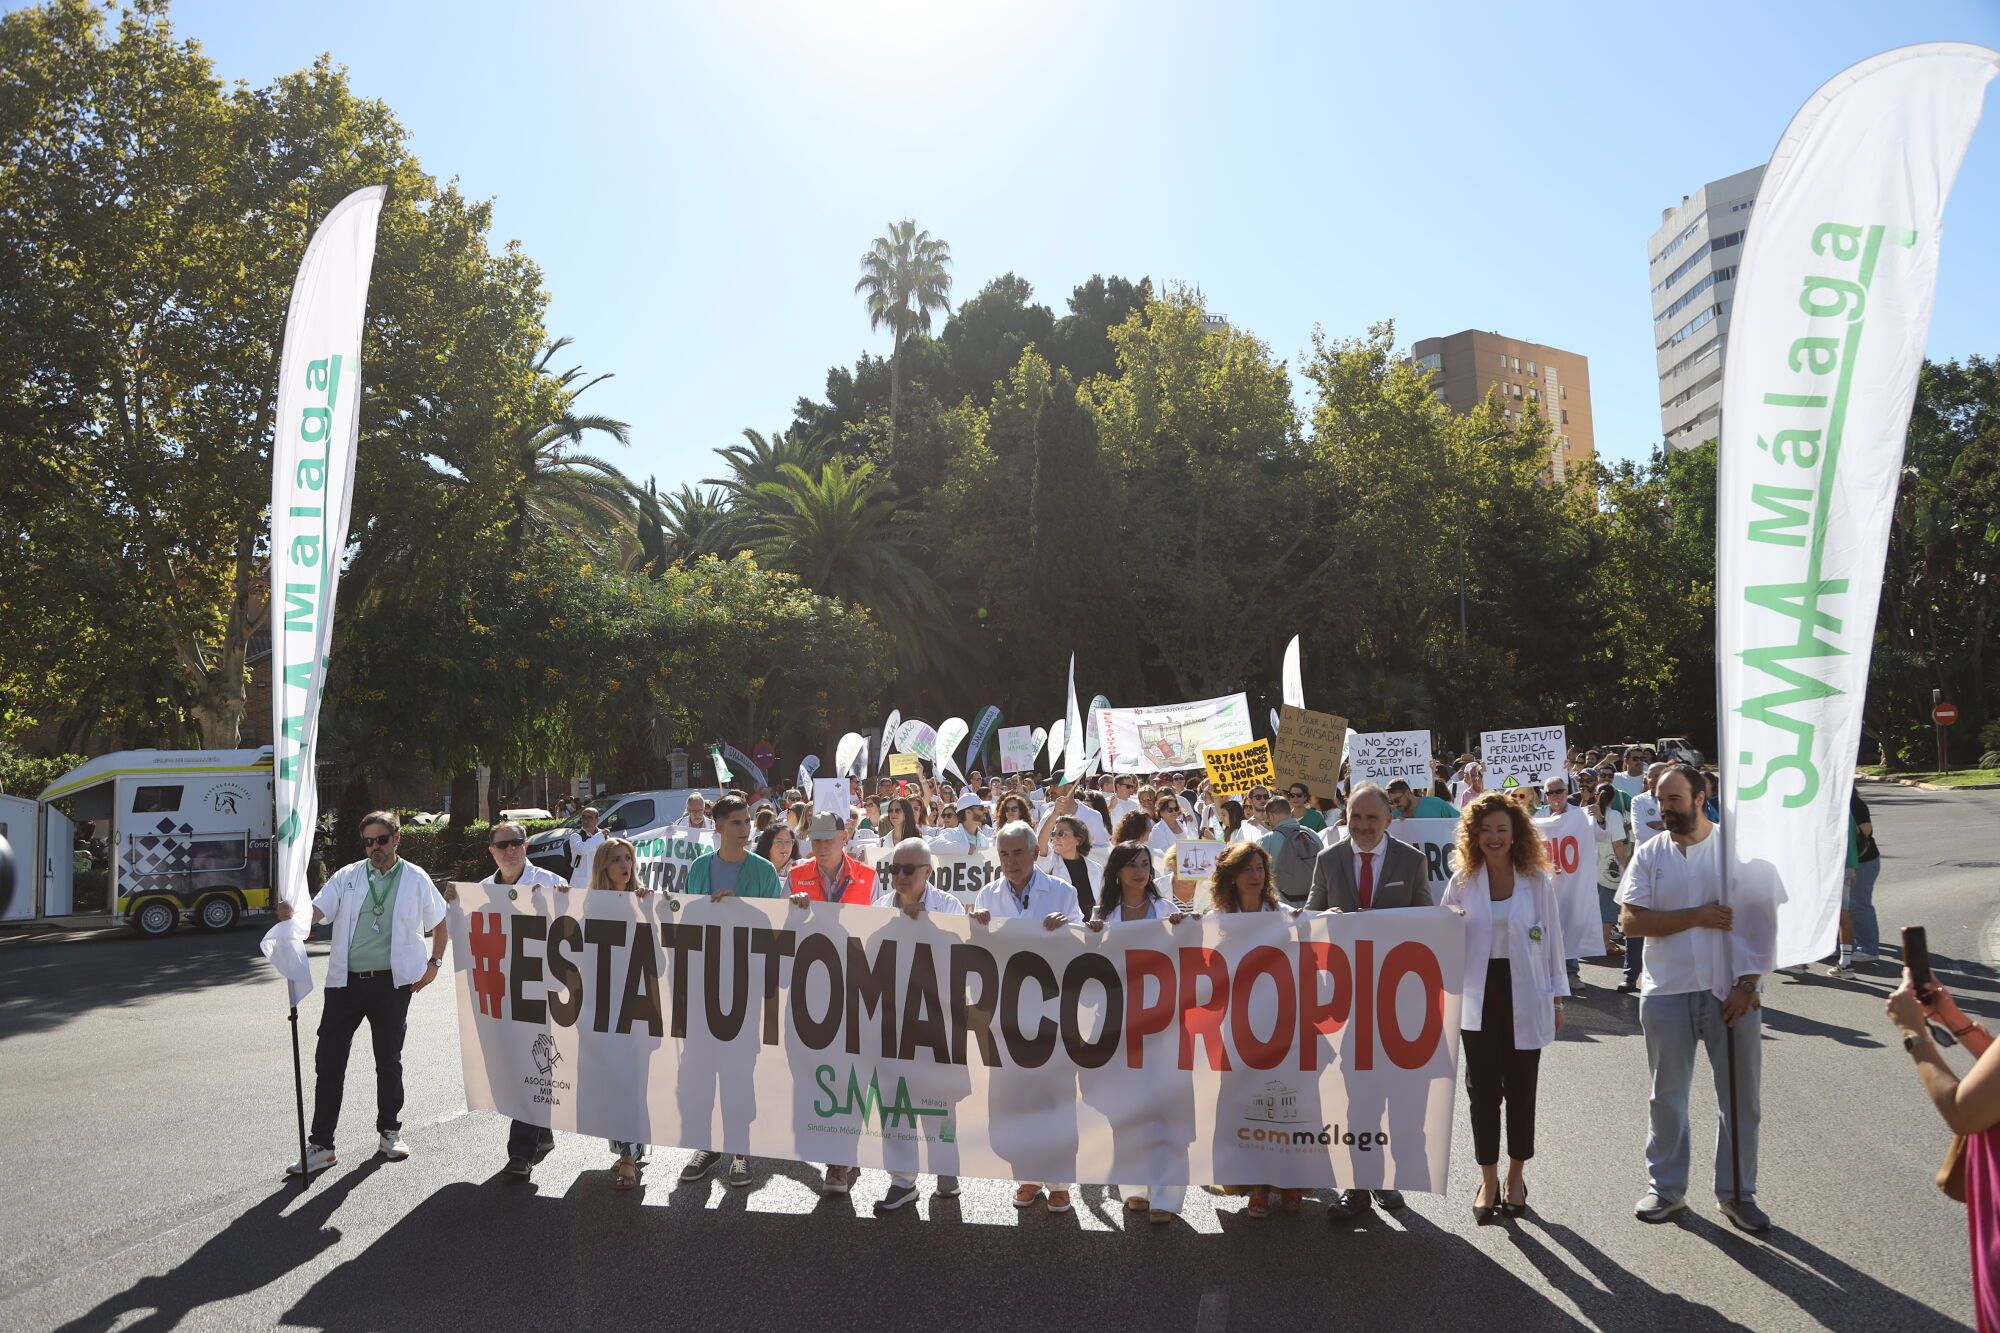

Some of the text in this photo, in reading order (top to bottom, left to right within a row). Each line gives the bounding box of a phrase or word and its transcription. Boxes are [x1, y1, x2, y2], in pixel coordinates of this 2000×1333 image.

[1731, 222, 1866, 808] SMA Málaga
[1365, 737, 1406, 746] NO SOY
[1501, 729, 1562, 743] ESTATUTO
[1358, 749, 1369, 757] UN
[1490, 743, 1547, 754] PERJUDICA
[1207, 751, 1243, 765] 38700
[1487, 750, 1555, 765] SERIAMENTE
[1230, 764, 1268, 781] HORAS
[1366, 764, 1425, 777] SALIENTE
[1510, 763, 1552, 775] SALUD
[469, 911, 1445, 1072] #ESTATUTOMARCOPROPIO
[524, 1077, 571, 1090] ASOCIACIÓN
[540, 1087, 552, 1096] MIR
[813, 1064, 948, 1131] SMA Málaga
[533, 1095, 560, 1106] ESPAÑA
[807, 1123, 838, 1134] Sindicato
[839, 1125, 864, 1136] Médico
[1237, 1124, 1389, 1151] commálaga
